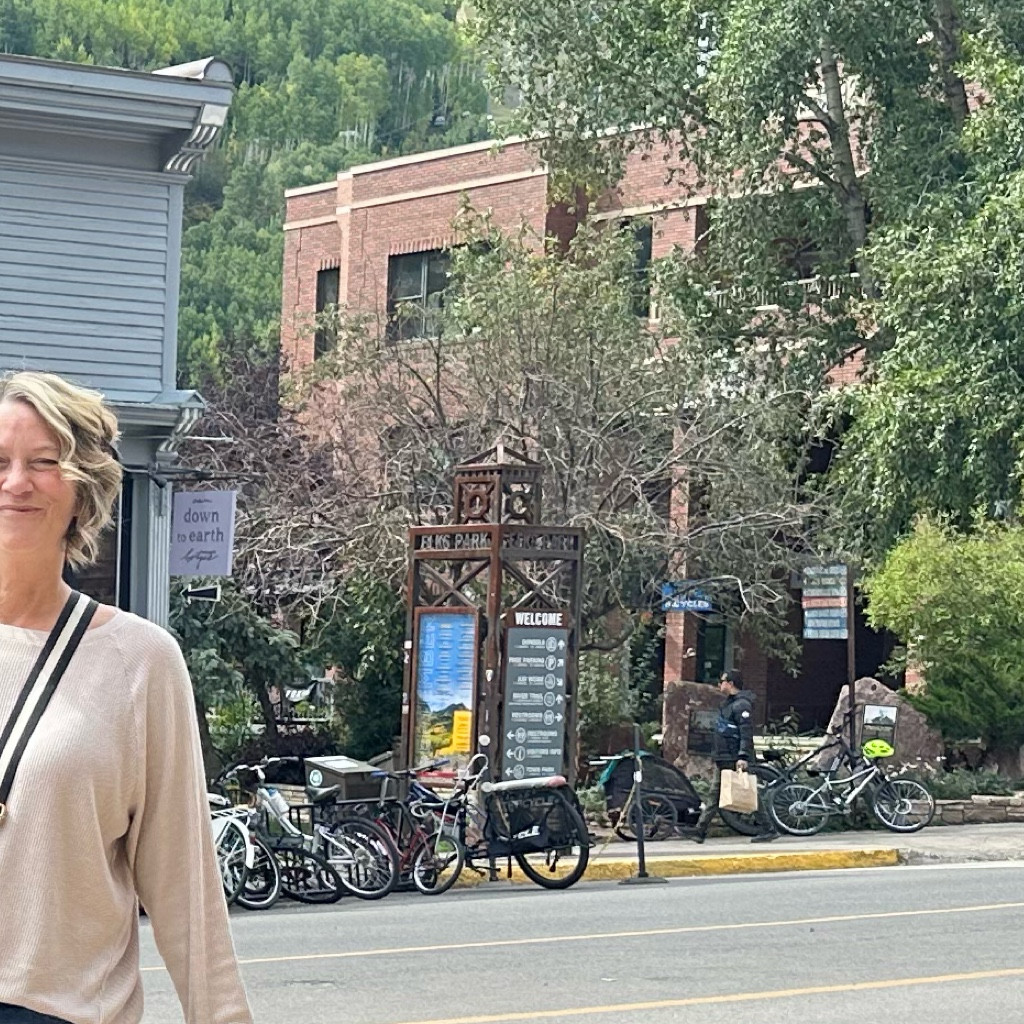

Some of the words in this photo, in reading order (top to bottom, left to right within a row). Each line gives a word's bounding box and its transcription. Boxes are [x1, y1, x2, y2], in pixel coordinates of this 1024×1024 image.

[183, 507, 220, 523] down
[177, 533, 187, 543] to
[189, 527, 224, 543] earth
[454, 532, 489, 549] PARK
[515, 612, 563, 626] WELCOME
